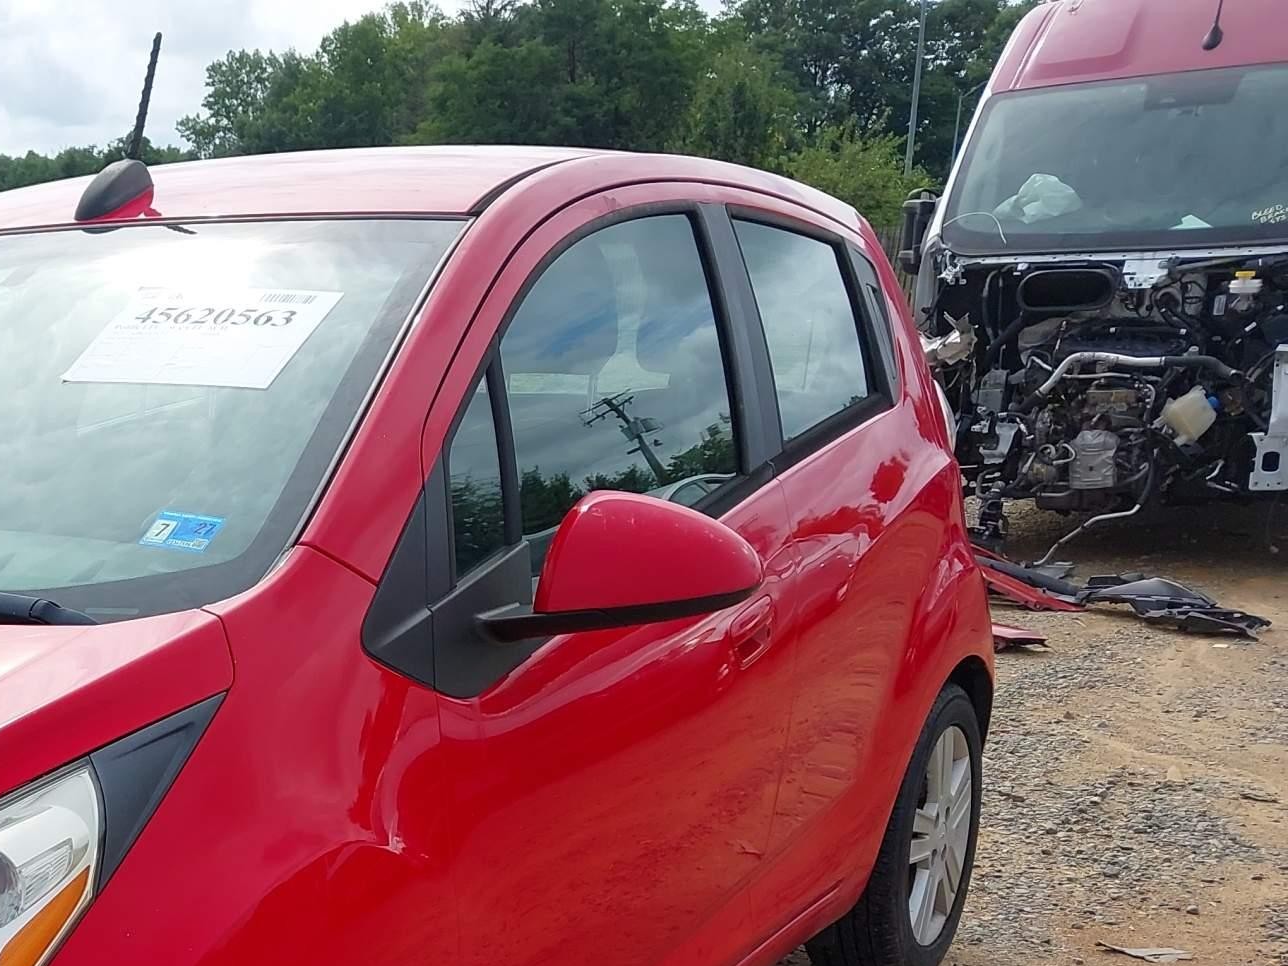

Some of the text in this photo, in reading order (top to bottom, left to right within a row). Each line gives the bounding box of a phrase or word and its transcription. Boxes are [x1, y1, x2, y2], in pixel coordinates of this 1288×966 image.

[135, 306, 298, 327] 45620563
[155, 522, 217, 537] 7 27
